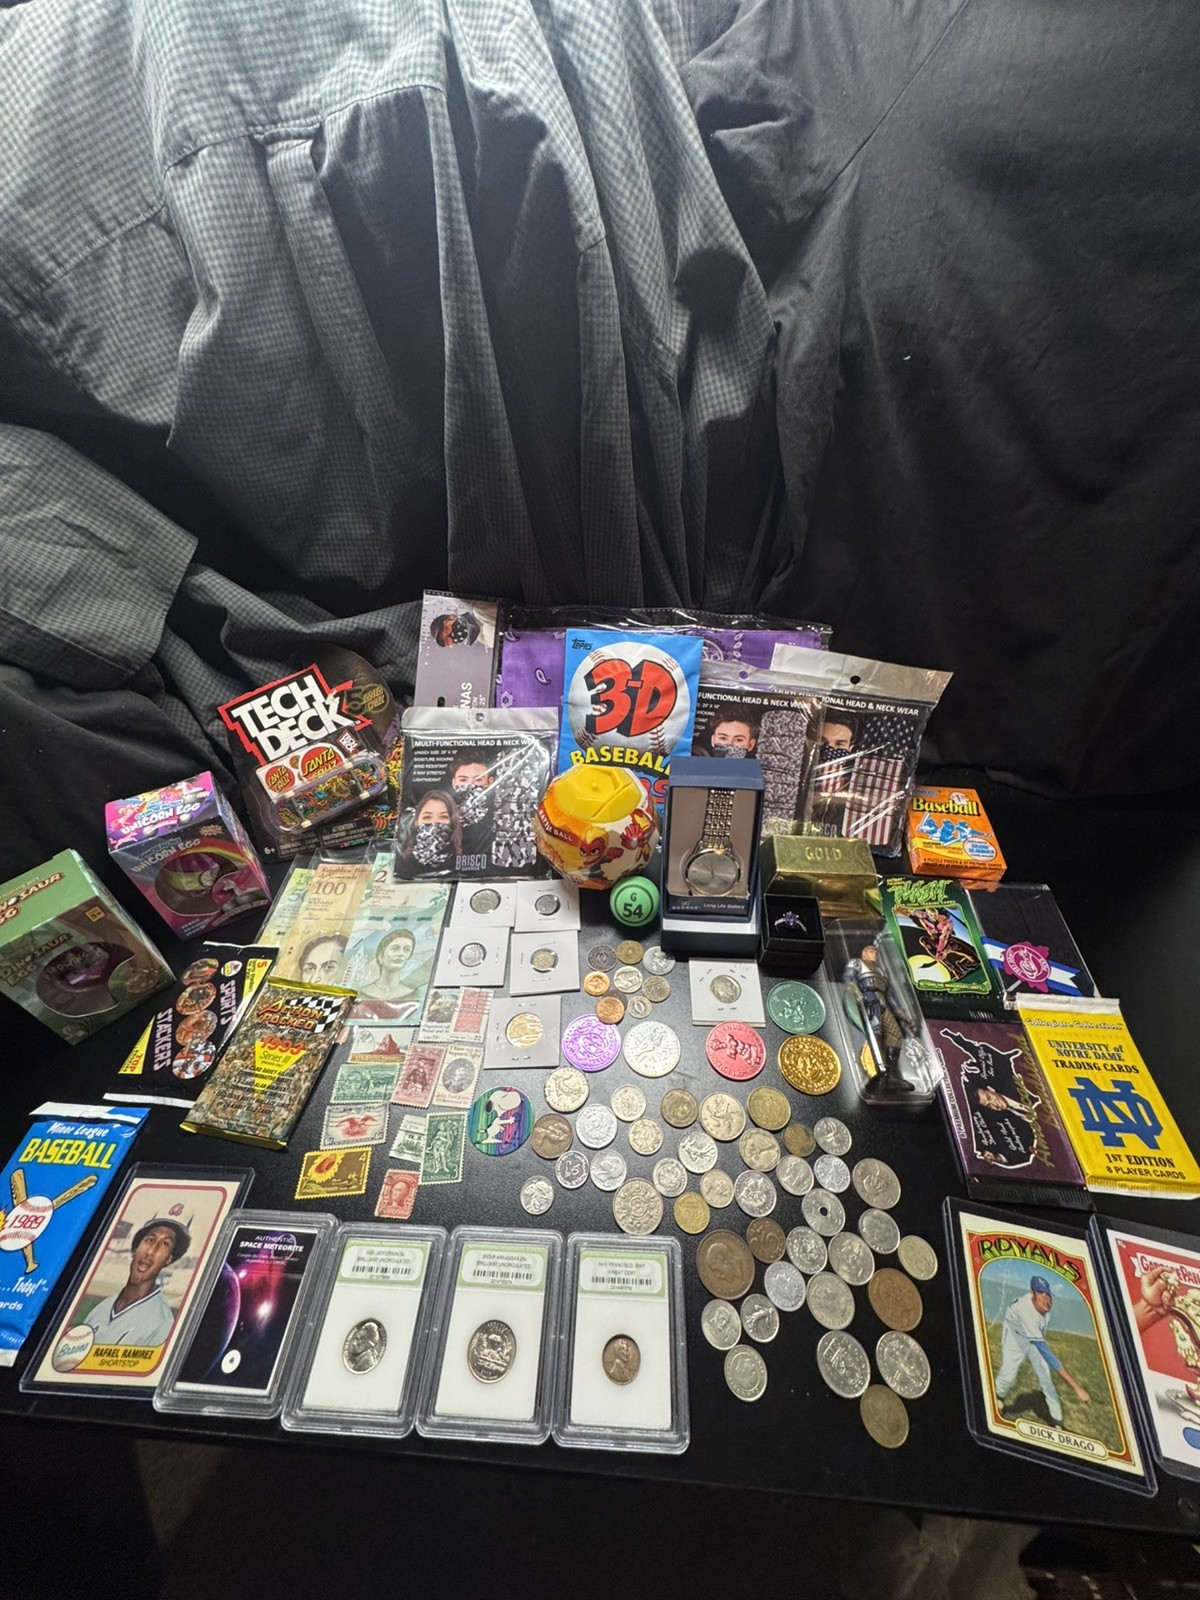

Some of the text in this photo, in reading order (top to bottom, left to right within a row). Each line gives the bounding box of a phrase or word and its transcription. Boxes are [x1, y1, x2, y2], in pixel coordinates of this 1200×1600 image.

[231, 674, 327, 738] TECH
[584, 658, 678, 738] 3-D
[742, 697, 762, 705] HEAD
[770, 699, 788, 708] NECK
[846, 700, 867, 709] HEAD
[868, 702, 874, 710] &
[876, 703, 895, 713] NECK
[897, 706, 919, 716] WEAR
[256, 690, 361, 761] DECK
[303, 747, 336, 777] SANTA
[267, 764, 288, 790] SANTA
[275, 773, 293, 793] CRUZ
[176, 802, 201, 815] EGG
[912, 797, 981, 816] Baseball
[121, 808, 174, 834] UNICORN
[538, 809, 553, 833] BATTLE
[554, 830, 573, 842] BALL
[178, 838, 201, 851] EGG
[264, 847, 276, 855] 6+
[131, 847, 178, 873] UNICORN
[804, 846, 843, 861] GOLD
[456, 854, 487, 870] BRISCO
[374, 869, 388, 883] 2
[312, 881, 347, 896] 100
[630, 893, 637, 901] G
[622, 903, 643, 918] 54
[256, 961, 268, 969] 5
[219, 979, 238, 1026] SPORTS
[257, 1000, 324, 1020] ACTION
[258, 1013, 316, 1031] PACKED
[153, 1007, 173, 1072] STACKERS
[260, 1036, 305, 1056] 1993
[1048, 1039, 1124, 1054] UNIVERSITY of
[128, 1053, 143, 1073] TOP
[260, 1050, 282, 1062] Series
[282, 1055, 291, 1064] III
[1056, 1048, 1125, 1062] NOTRE DAME
[1052, 1060, 1140, 1074] TRADING CARDS
[46, 1121, 110, 1139] Minor League
[18, 1137, 117, 1169] BASEBALL
[359, 1152, 366, 1162] 4
[1105, 1153, 1176, 1168] 1ST EDITION
[451, 1163, 459, 1179] 3
[1105, 1165, 1187, 1180] 8 PLAYER CARDS
[10, 1214, 46, 1230] 1989
[239, 1241, 304, 1252] SPACE METEORITE
[255, 1235, 293, 1243] AUTHENTIC
[978, 1237, 1081, 1283] ROYALS
[93, 1347, 155, 1359] RAFAEL RAMIREZ
[99, 1358, 140, 1368] SHORTSTOP
[1029, 1425, 1095, 1452] DICK DRAGO
